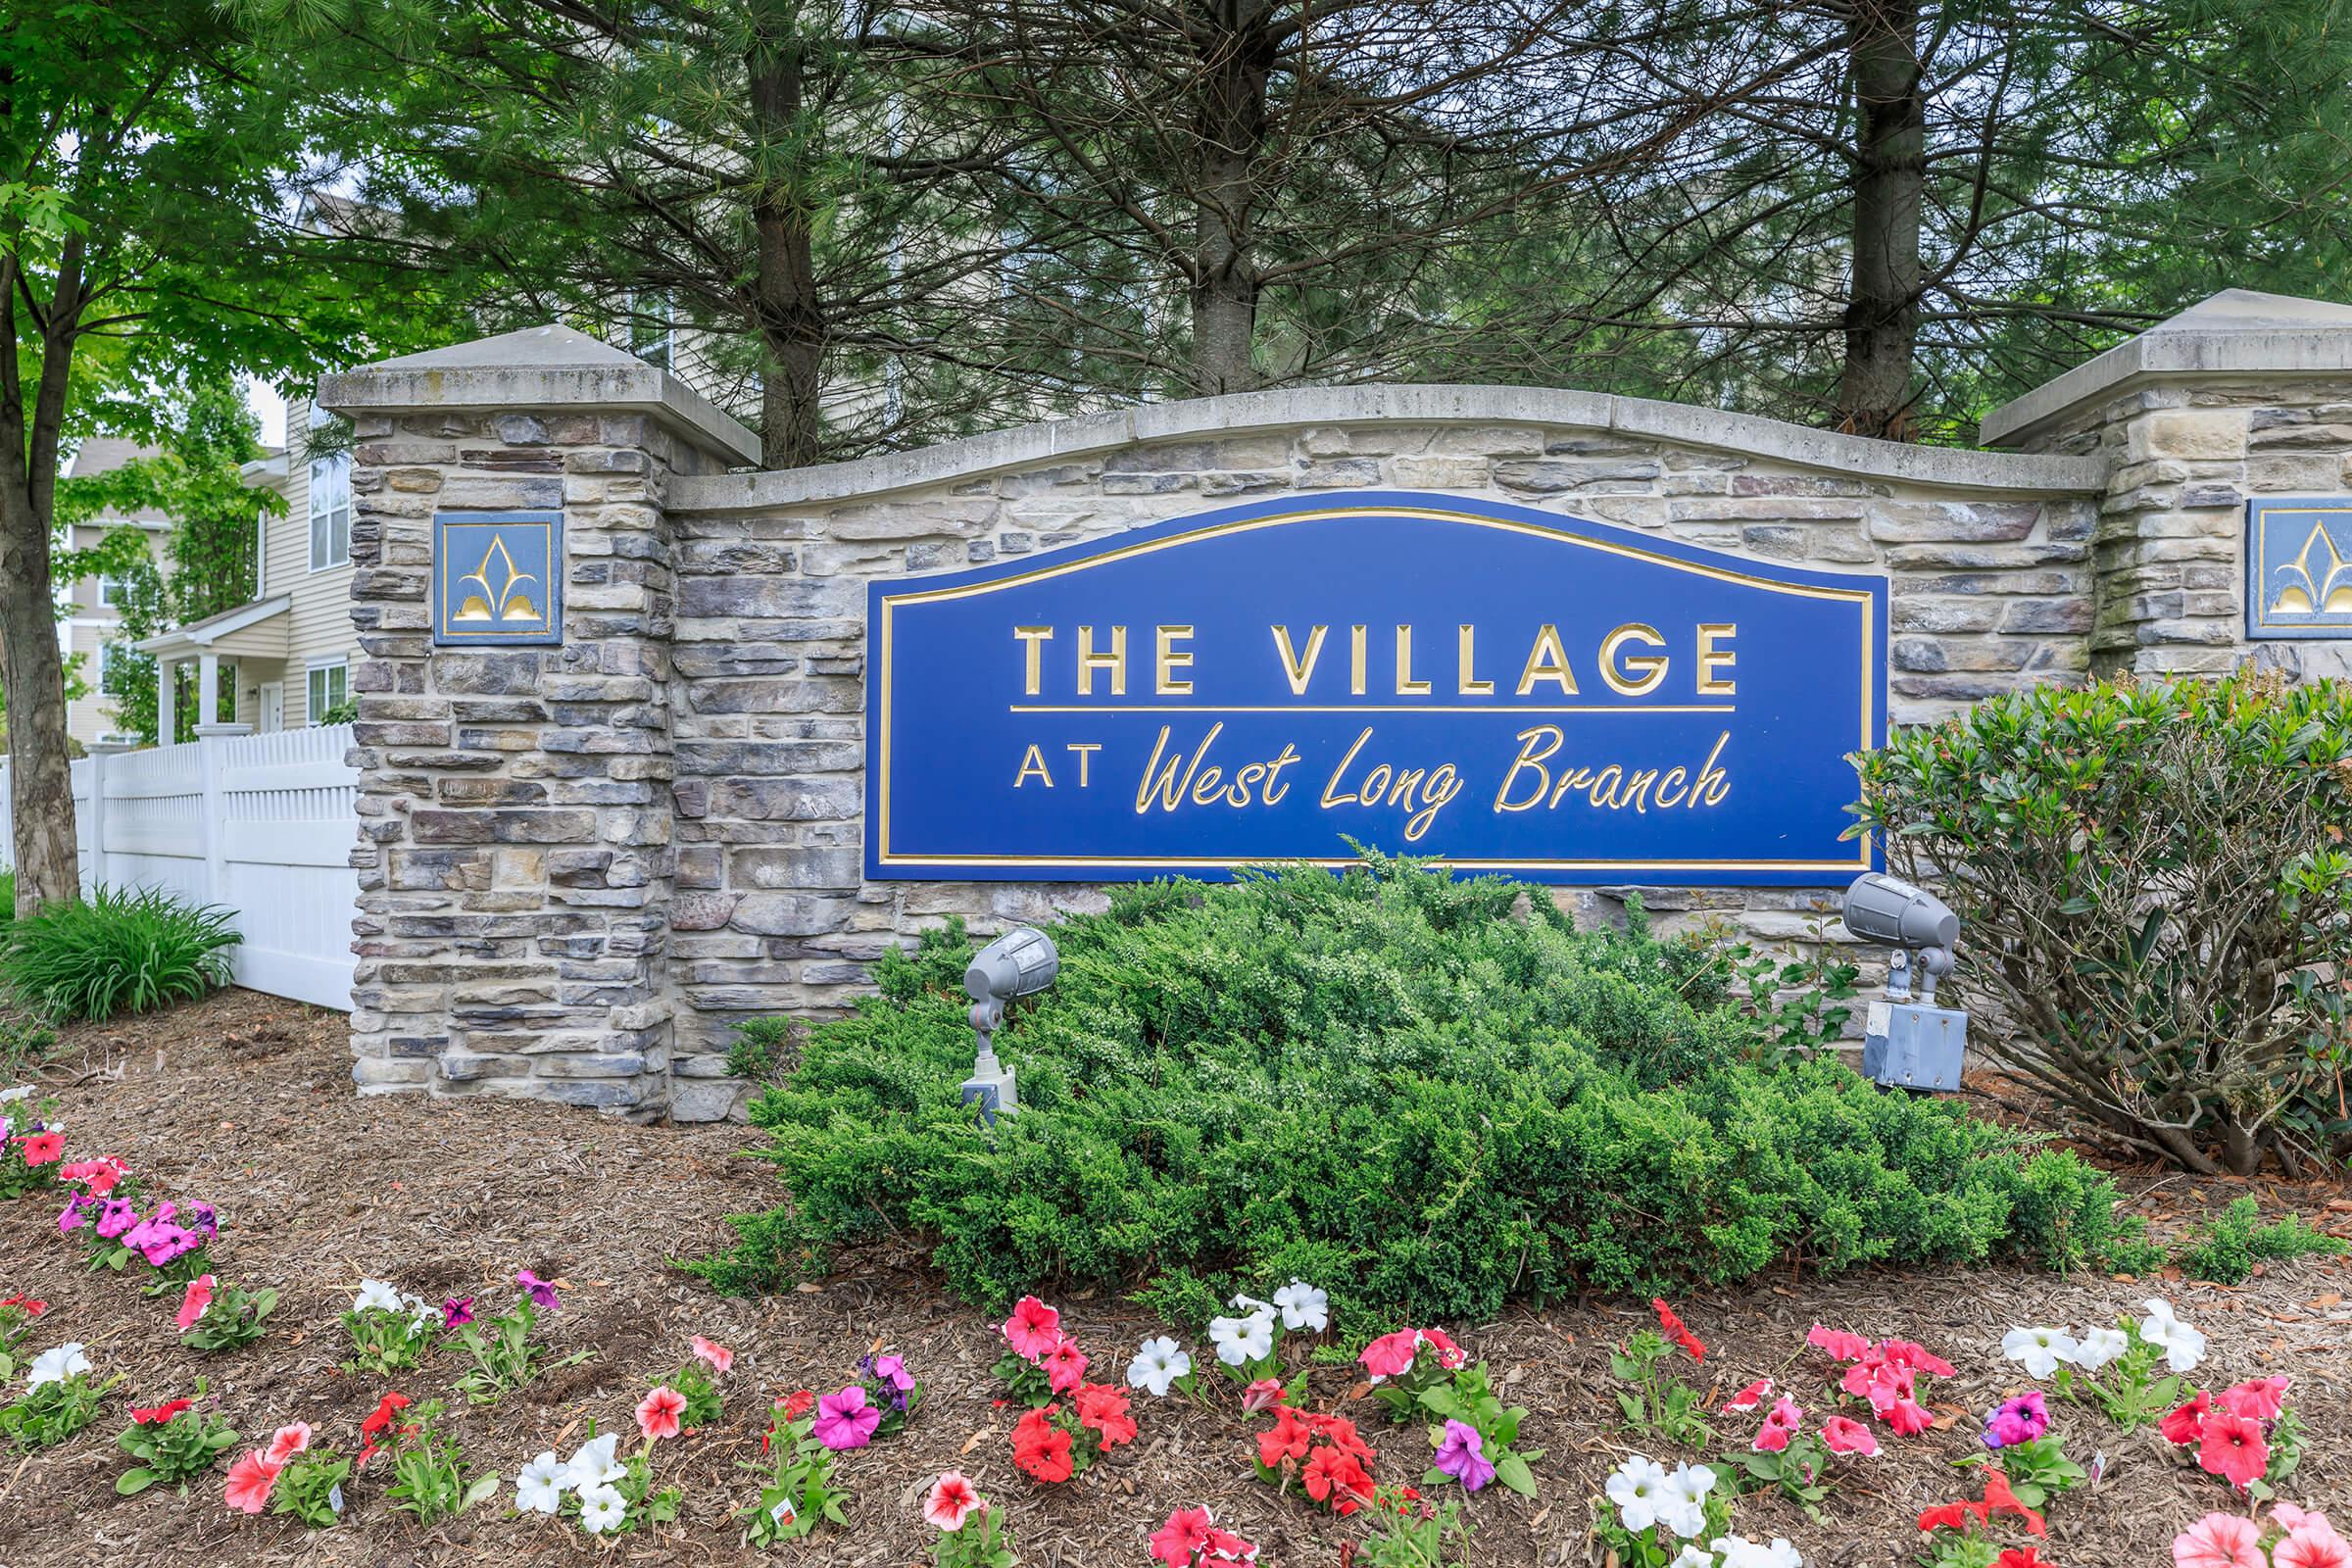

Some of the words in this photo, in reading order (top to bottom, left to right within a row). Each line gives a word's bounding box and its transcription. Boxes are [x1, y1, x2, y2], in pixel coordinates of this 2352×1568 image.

[1012, 623, 1196, 697] THE
[1270, 621, 1739, 698] VILLAGE
[1012, 743, 1103, 788] AT
[1135, 720, 1302, 815] West
[1319, 725, 1465, 843] Long
[1493, 722, 1732, 815] Branch
